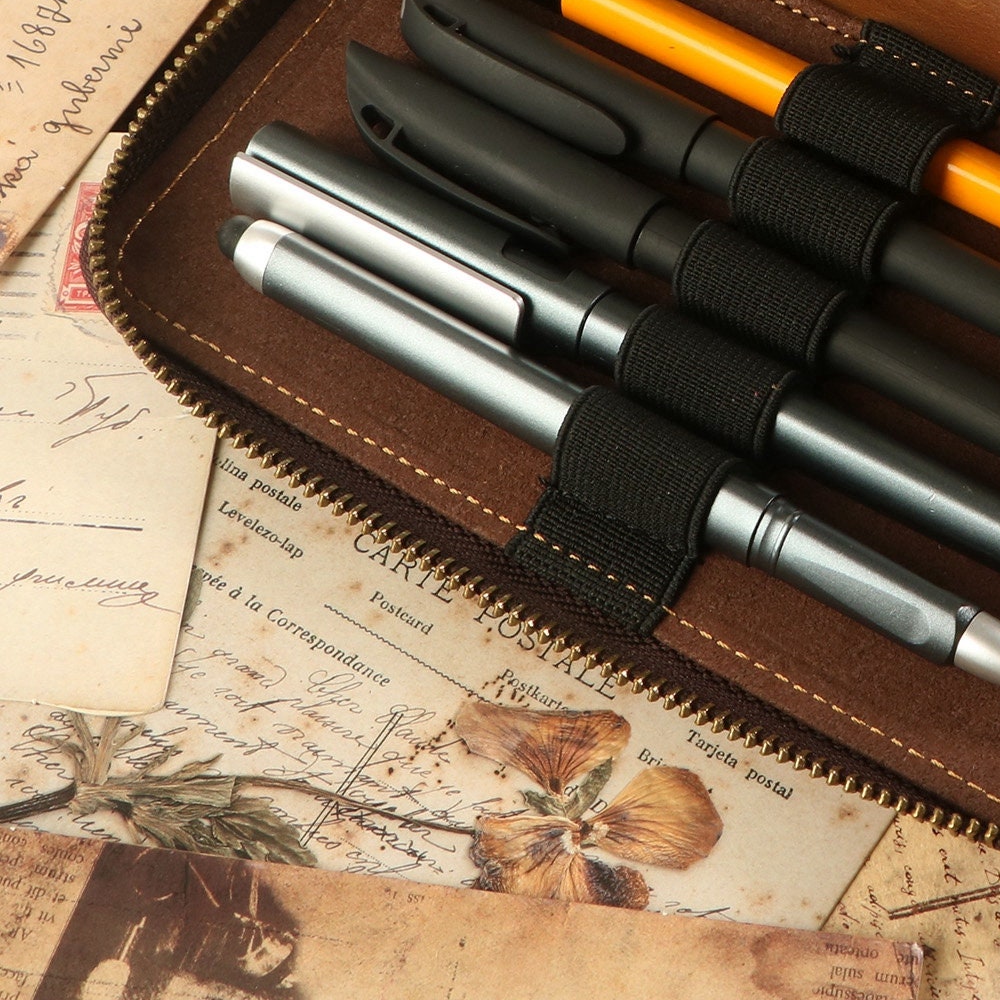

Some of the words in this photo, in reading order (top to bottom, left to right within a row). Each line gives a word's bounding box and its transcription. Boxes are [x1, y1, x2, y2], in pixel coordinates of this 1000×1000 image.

[213, 456, 249, 483] lina
[249, 477, 303, 513] postale
[217, 500, 305, 561] Levelezo-lap
[228, 587, 244, 602] à
[244, 595, 264, 615] la
[266, 607, 392, 688] Correspondance
[369, 590, 435, 637] Postcard
[472, 604, 617, 702] POSTALE
[686, 728, 739, 770] Tarjeta
[744, 766, 795, 801] postal
